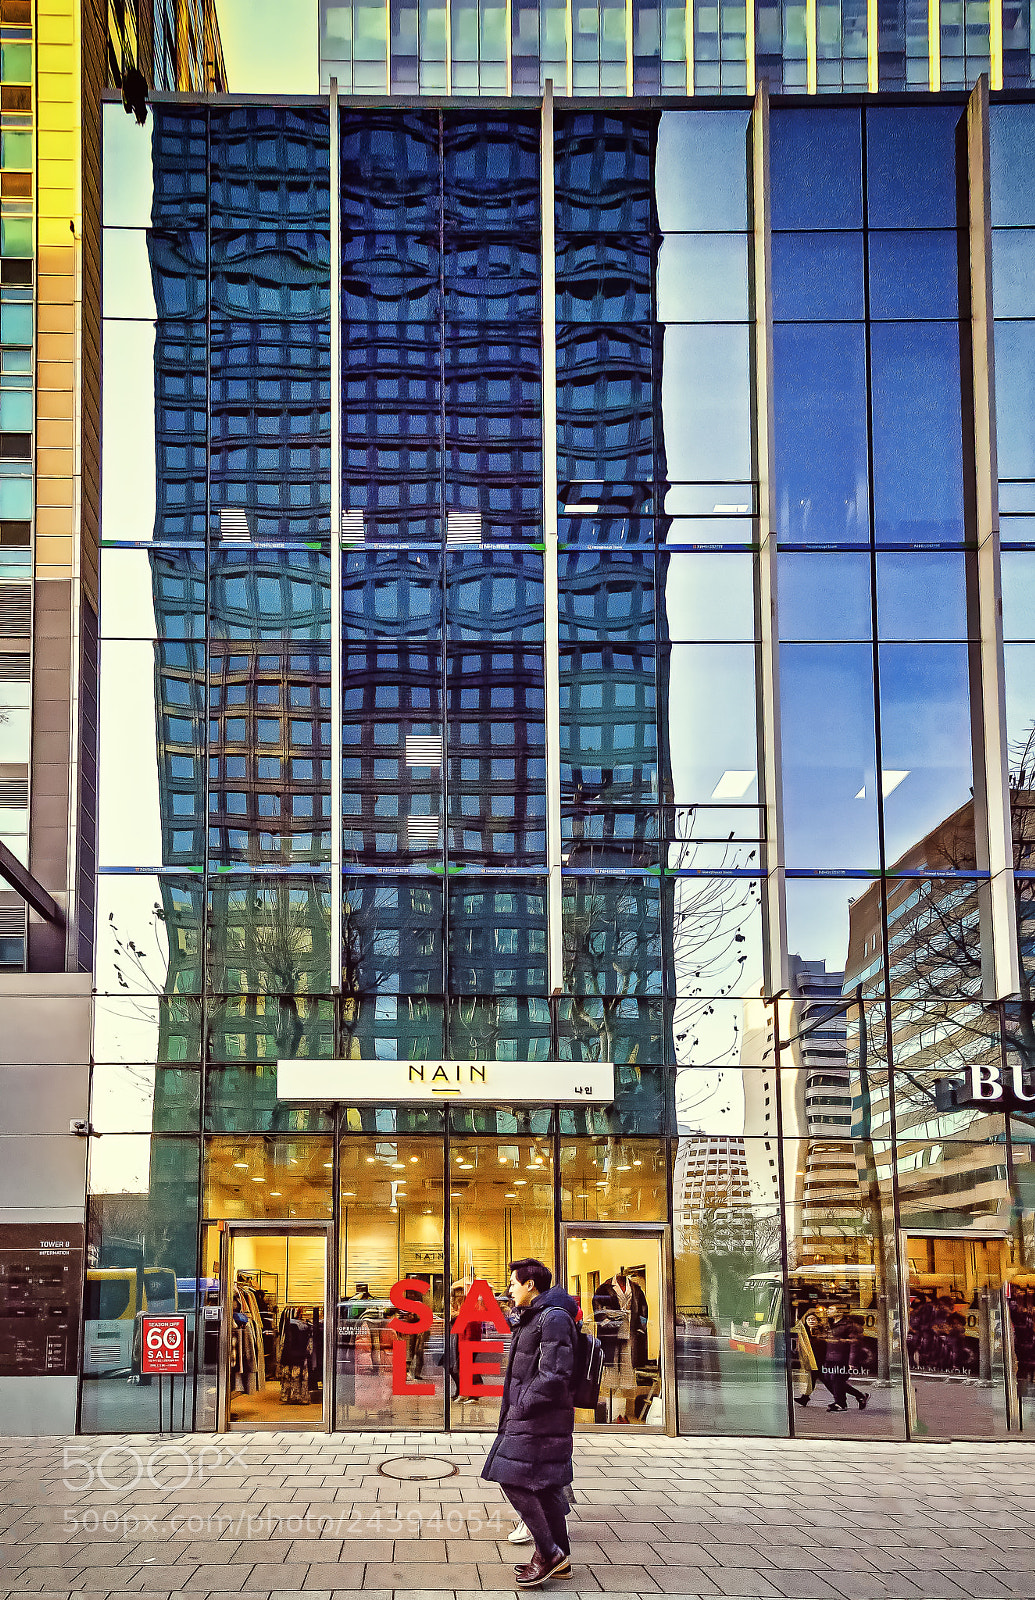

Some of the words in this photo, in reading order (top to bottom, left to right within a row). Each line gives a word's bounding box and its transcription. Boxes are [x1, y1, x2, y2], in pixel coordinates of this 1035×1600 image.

[408, 1065, 485, 1082] NAIN
[574, 1086, 593, 1095] 나인
[415, 1252, 444, 1260] NAIN
[146, 1327, 182, 1350] 60
[147, 1350, 180, 1359] SALE
[821, 1365, 869, 1375] build.co.kr
